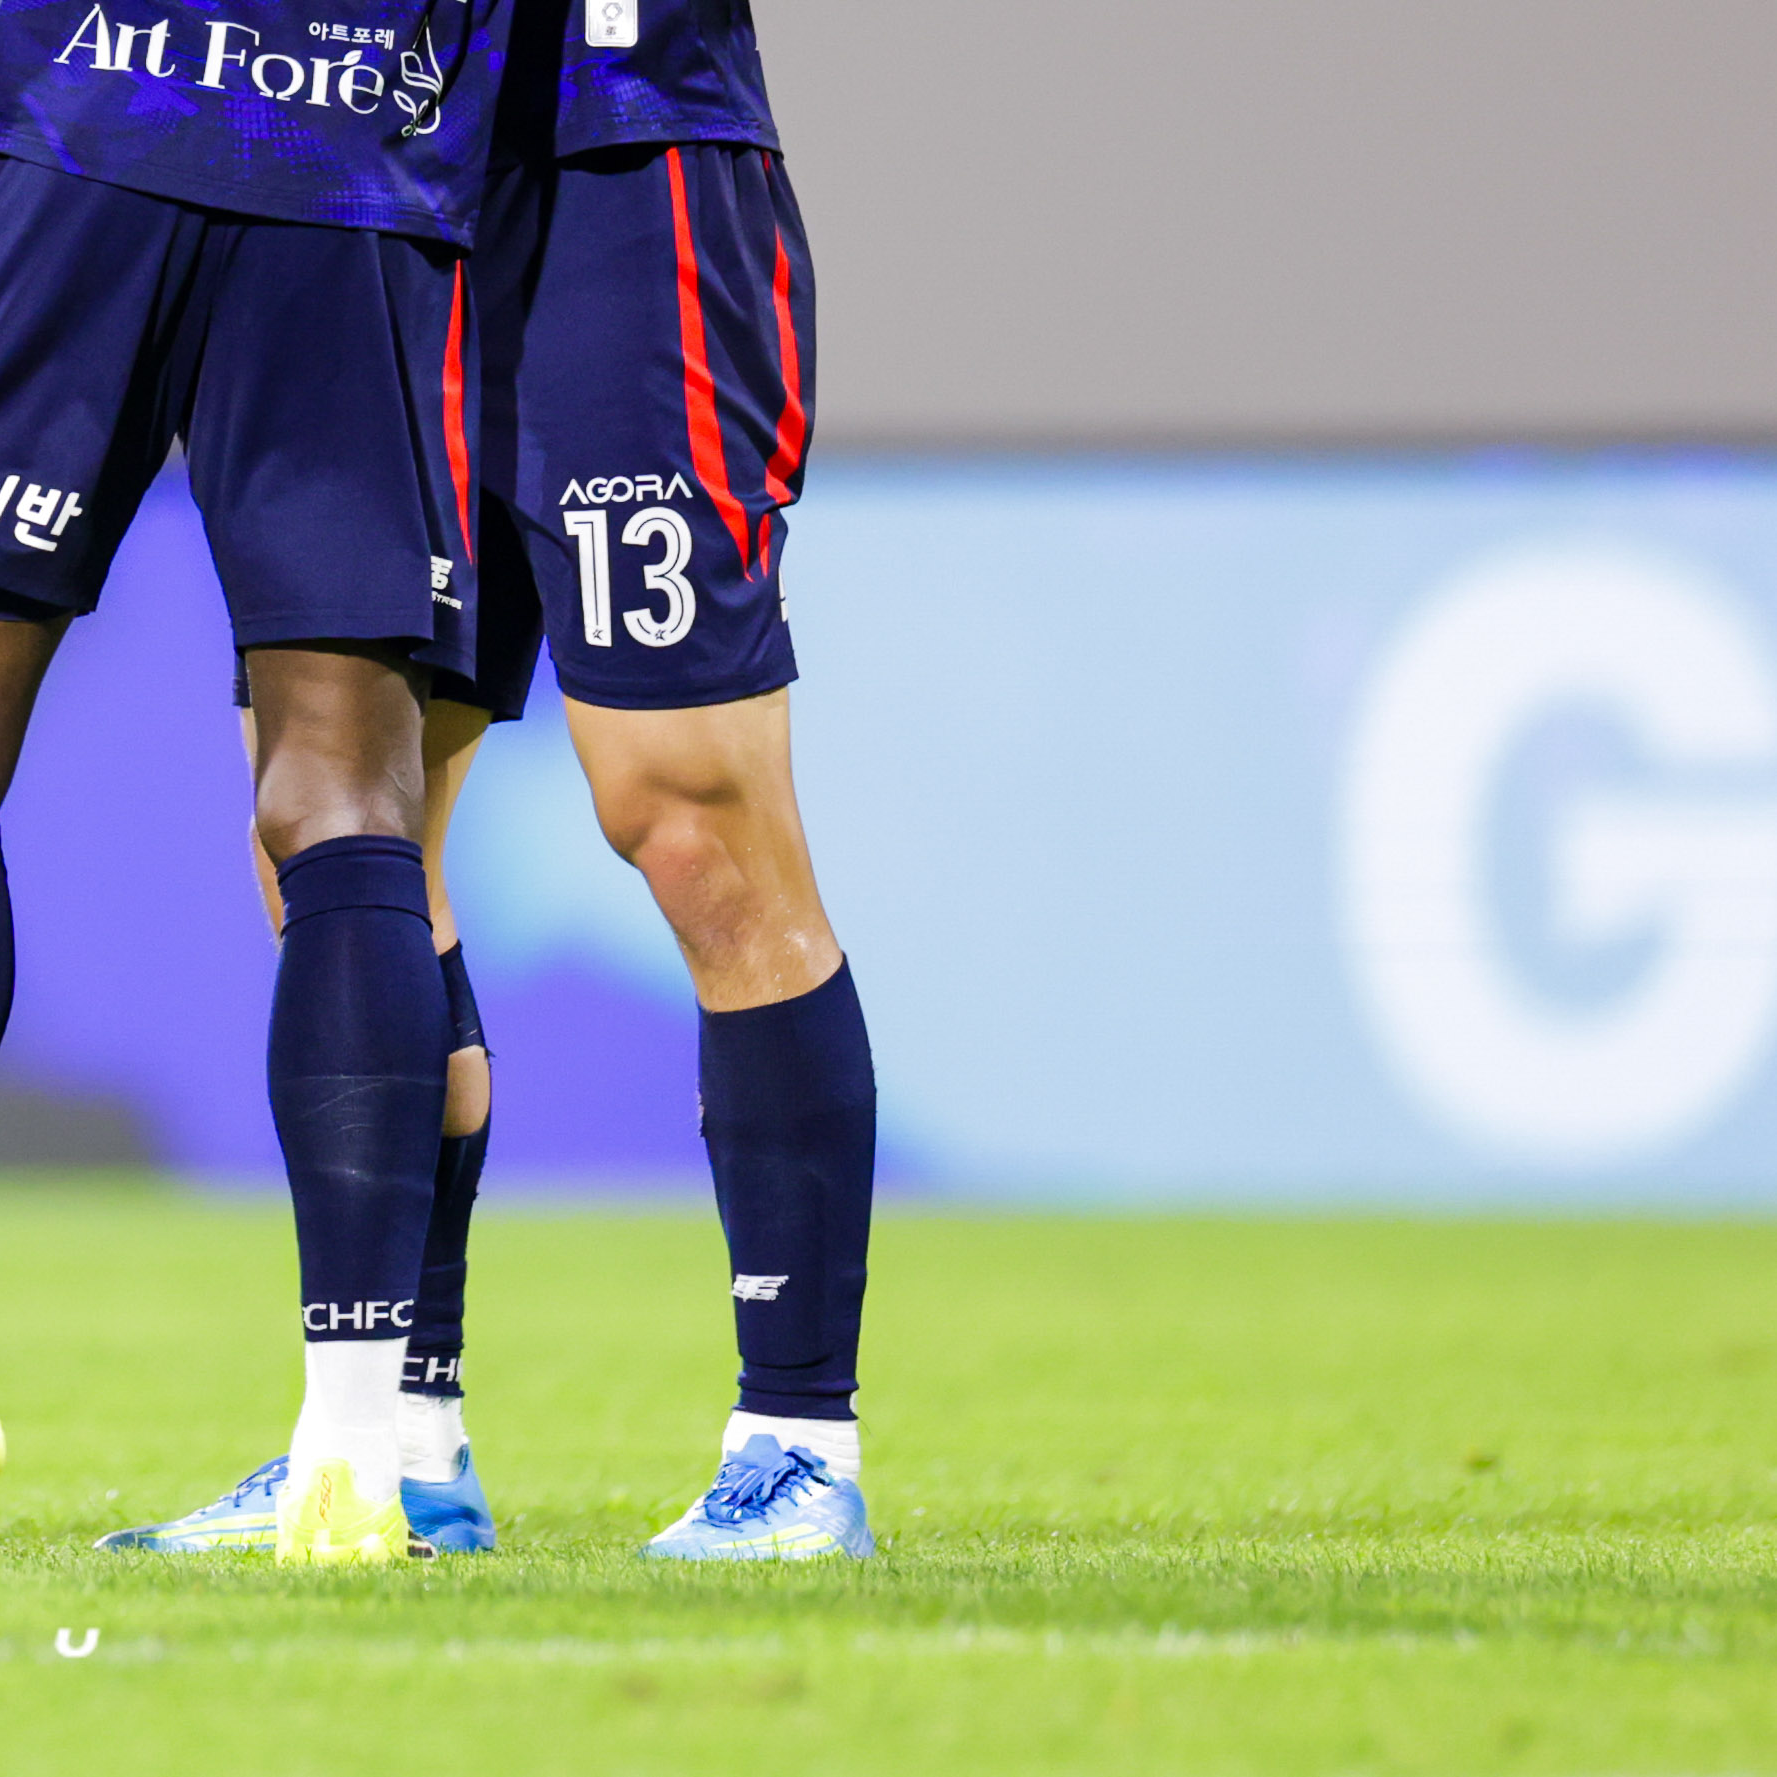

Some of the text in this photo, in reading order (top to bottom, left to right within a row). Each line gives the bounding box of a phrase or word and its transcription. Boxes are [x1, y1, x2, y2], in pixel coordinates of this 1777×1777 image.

[53, 3, 176, 78] Art
[308, 21, 395, 51] 아트포레
[559, 472, 694, 505] AGORA
[563, 506, 696, 648] 13
[303, 1298, 415, 1331] CHFC
